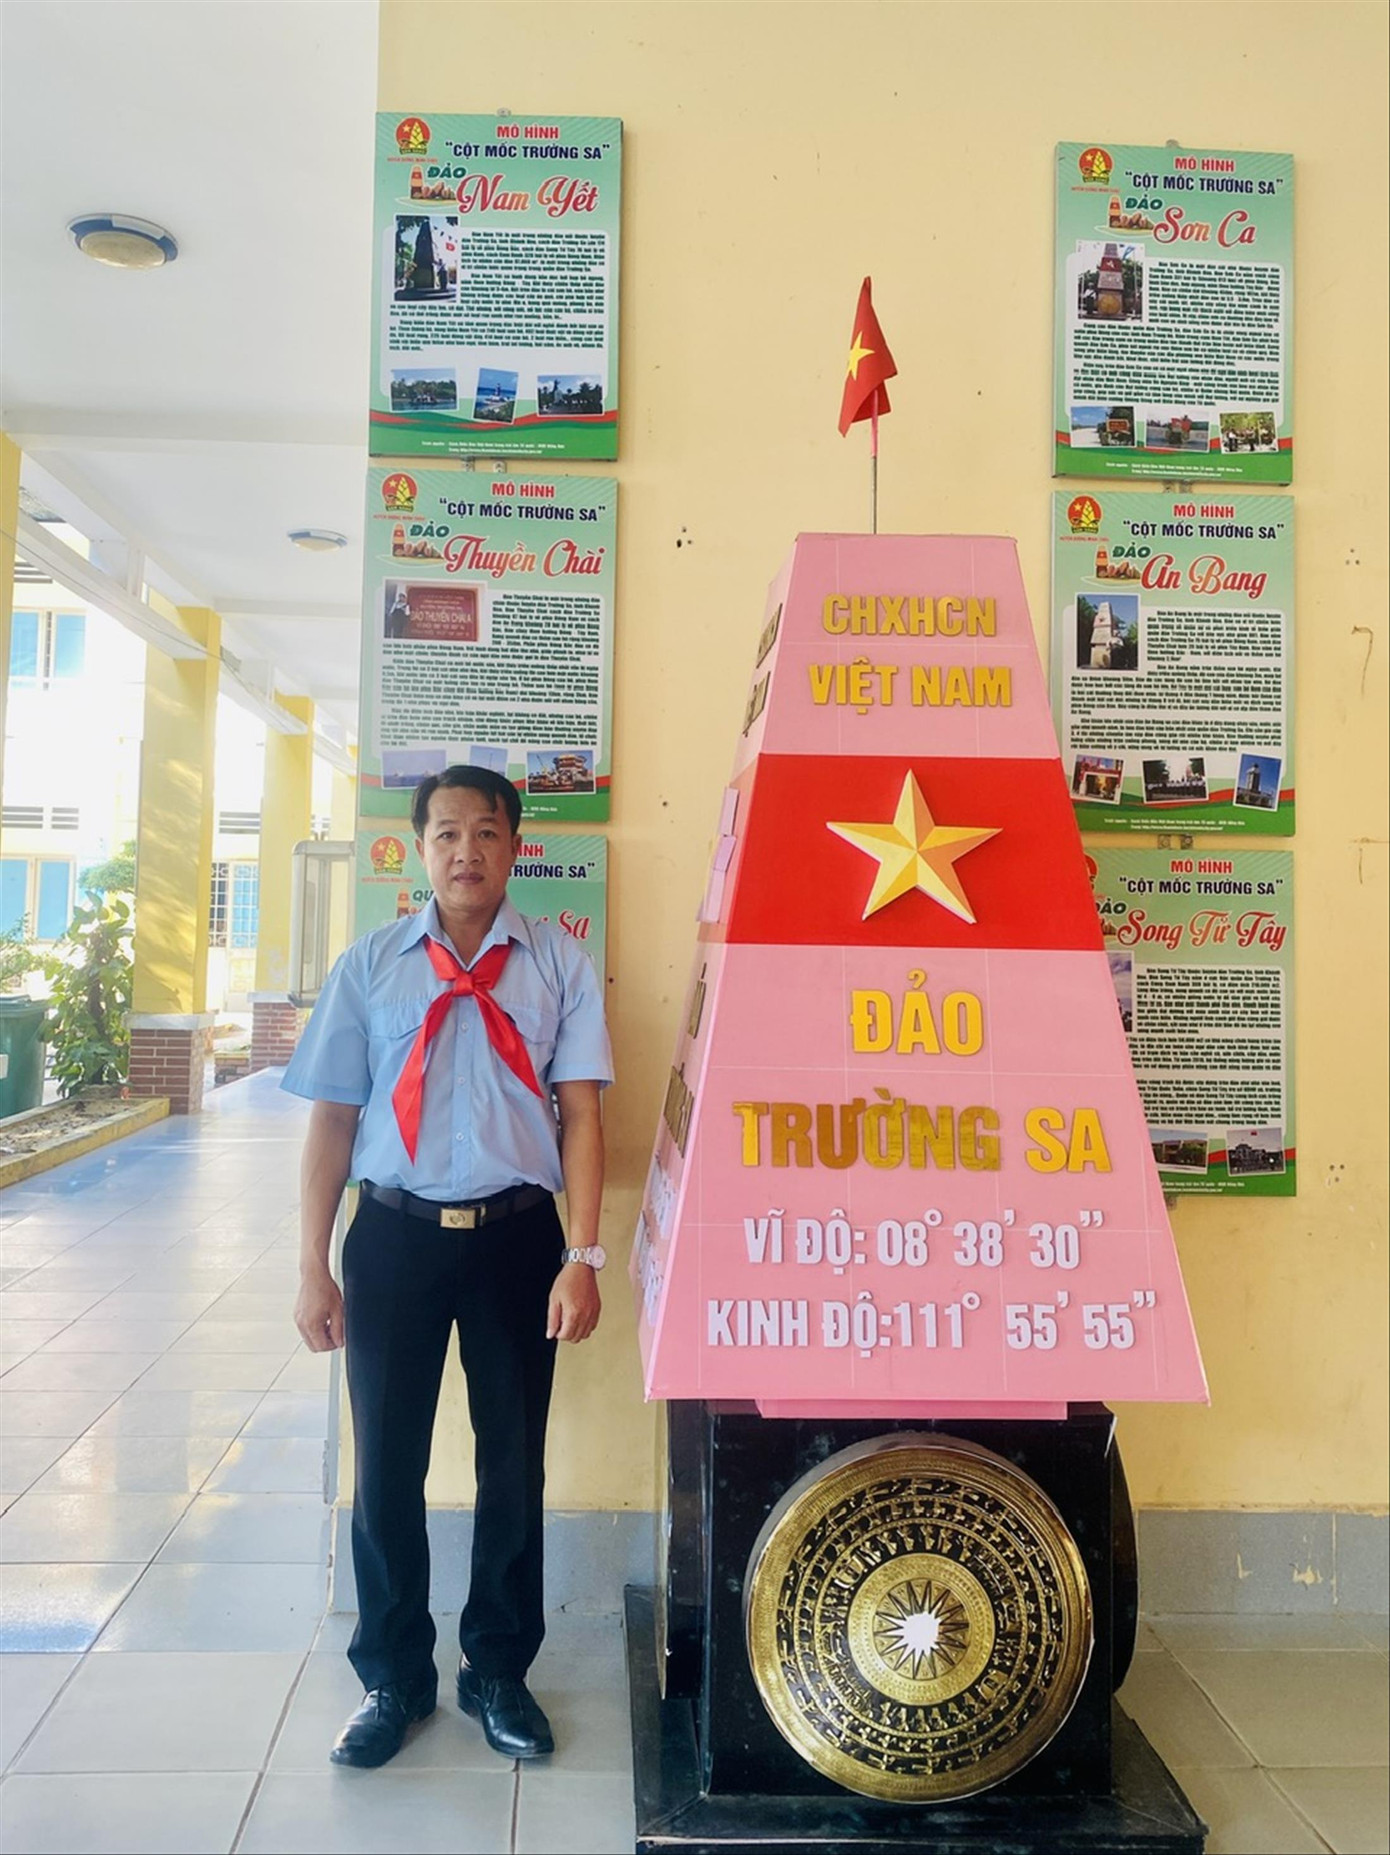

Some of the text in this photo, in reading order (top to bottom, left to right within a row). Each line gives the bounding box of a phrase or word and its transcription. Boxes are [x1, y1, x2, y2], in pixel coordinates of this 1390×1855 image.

[525, 126, 559, 139] HÌNH
[485, 141, 517, 158] MỐC
[522, 144, 578, 159] TRƯỜNG
[427, 163, 467, 179] ĐẢO
[1164, 173, 1194, 190] MỐC
[1199, 177, 1253, 193] TRƯỜNG
[456, 175, 598, 217] Nam Yết
[1125, 194, 1163, 209] ĐẢO
[1218, 210, 1255, 247] Ca
[520, 484, 555, 498] HÌNH
[480, 500, 512, 518] MỐC
[517, 504, 574, 520] TRƯỜNG
[1200, 505, 1234, 518] HÌNH
[410, 521, 450, 538] ĐẢO
[1162, 520, 1193, 537] MỐC
[1198, 523, 1254, 538] TRƯỜNG
[443, 535, 605, 579] Thuyền Chài
[1112, 542, 1151, 558] ĐẢO
[1141, 554, 1267, 599] An Bang
[822, 594, 997, 636] CHXHCN
[808, 655, 1012, 715] VIỆT NAM
[1198, 860, 1232, 873] HÌNH
[1159, 876, 1191, 893] MỐC
[1196, 879, 1252, 894] TRƯỜNG
[1117, 909, 1287, 952] Song Tử Tây
[850, 969, 984, 1055] ĐẢO
[733, 1087, 1113, 1173] TRƯỜNG SA
[743, 1208, 785, 1264] VĨ
[795, 1208, 866, 1275] ĐỘ:
[707, 1299, 808, 1347] KINH
